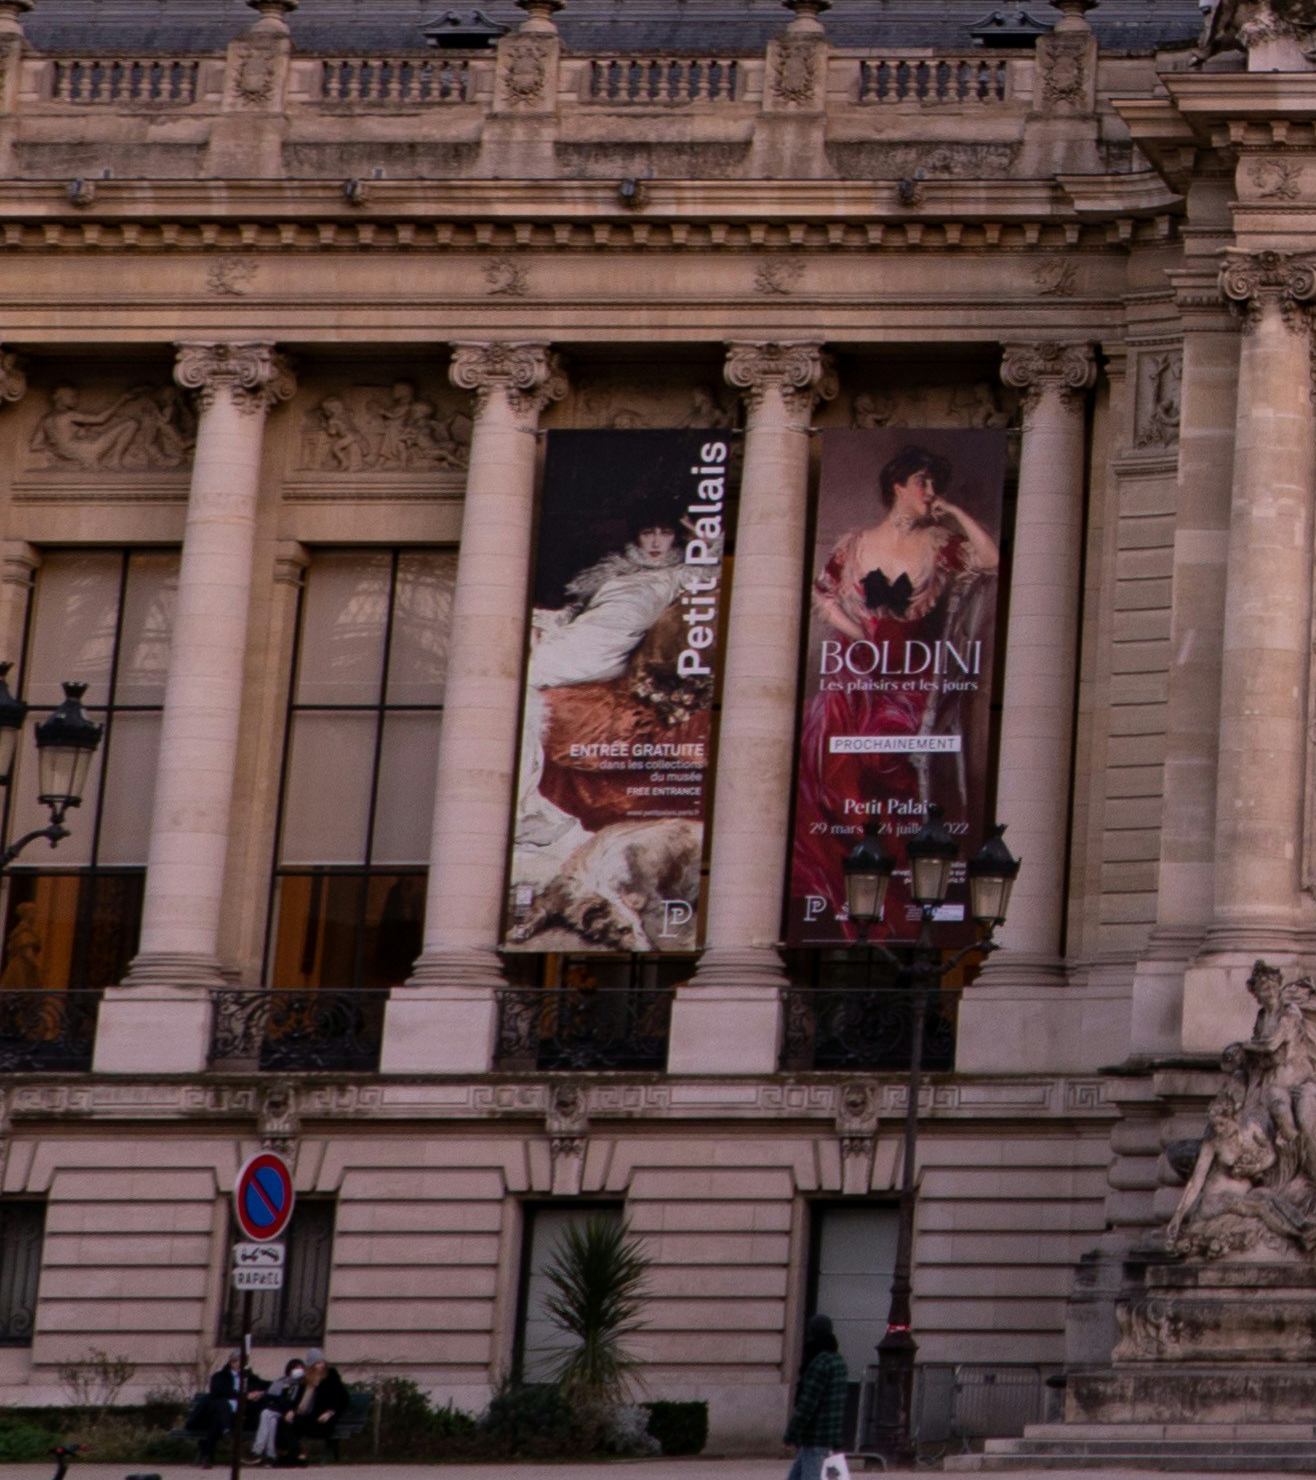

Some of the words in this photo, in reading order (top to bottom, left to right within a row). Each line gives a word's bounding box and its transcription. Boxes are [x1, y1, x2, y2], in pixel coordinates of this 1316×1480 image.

[685, 441, 727, 565] Palais
[677, 577, 717, 676] Petit
[819, 639, 982, 675] BOLDINI
[820, 679, 844, 691] Les
[847, 678, 898, 694] plaisirs
[902, 680, 915, 691] et
[919, 679, 938, 691] les
[942, 679, 978, 694] jours
[570, 739, 630, 757] ENTRÉE
[632, 743, 705, 757] GRATUITE
[834, 738, 956, 751] PROCHAINEMENT
[601, 759, 626, 770] dans
[628, 759, 643, 769] les
[645, 759, 704, 769] collections
[650, 771, 665, 782] du
[666, 771, 703, 782] musée
[626, 786, 650, 796] FREE
[652, 786, 702, 796] ENTRANCE
[844, 798, 882, 815] Petit
[809, 821, 827, 835] 29
[830, 824, 864, 835] mars
